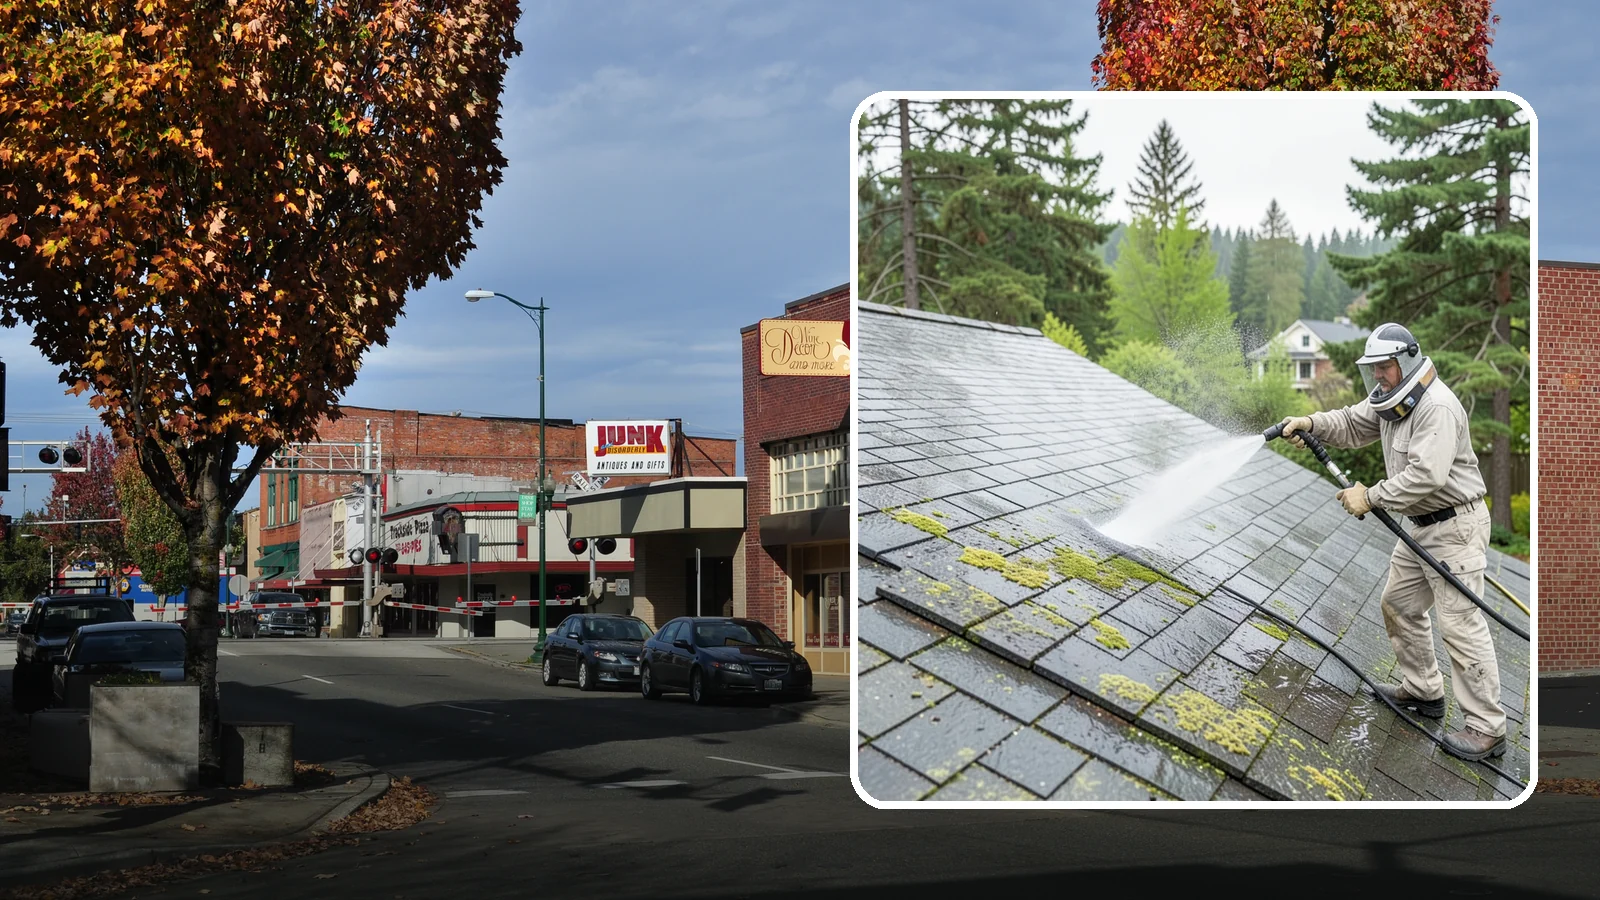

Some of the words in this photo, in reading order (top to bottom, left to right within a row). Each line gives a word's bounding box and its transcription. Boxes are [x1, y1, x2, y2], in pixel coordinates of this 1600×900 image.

[765, 328, 830, 365] Decor
[595, 425, 665, 457] JUNK
[607, 446, 646, 454] DISORDERLY
[597, 461, 628, 470] ANTIQUES
[631, 461, 644, 470] AND
[647, 460, 665, 470] GIFTS
[390, 521, 413, 539] Trackside
[414, 519, 429, 534] Pizza
